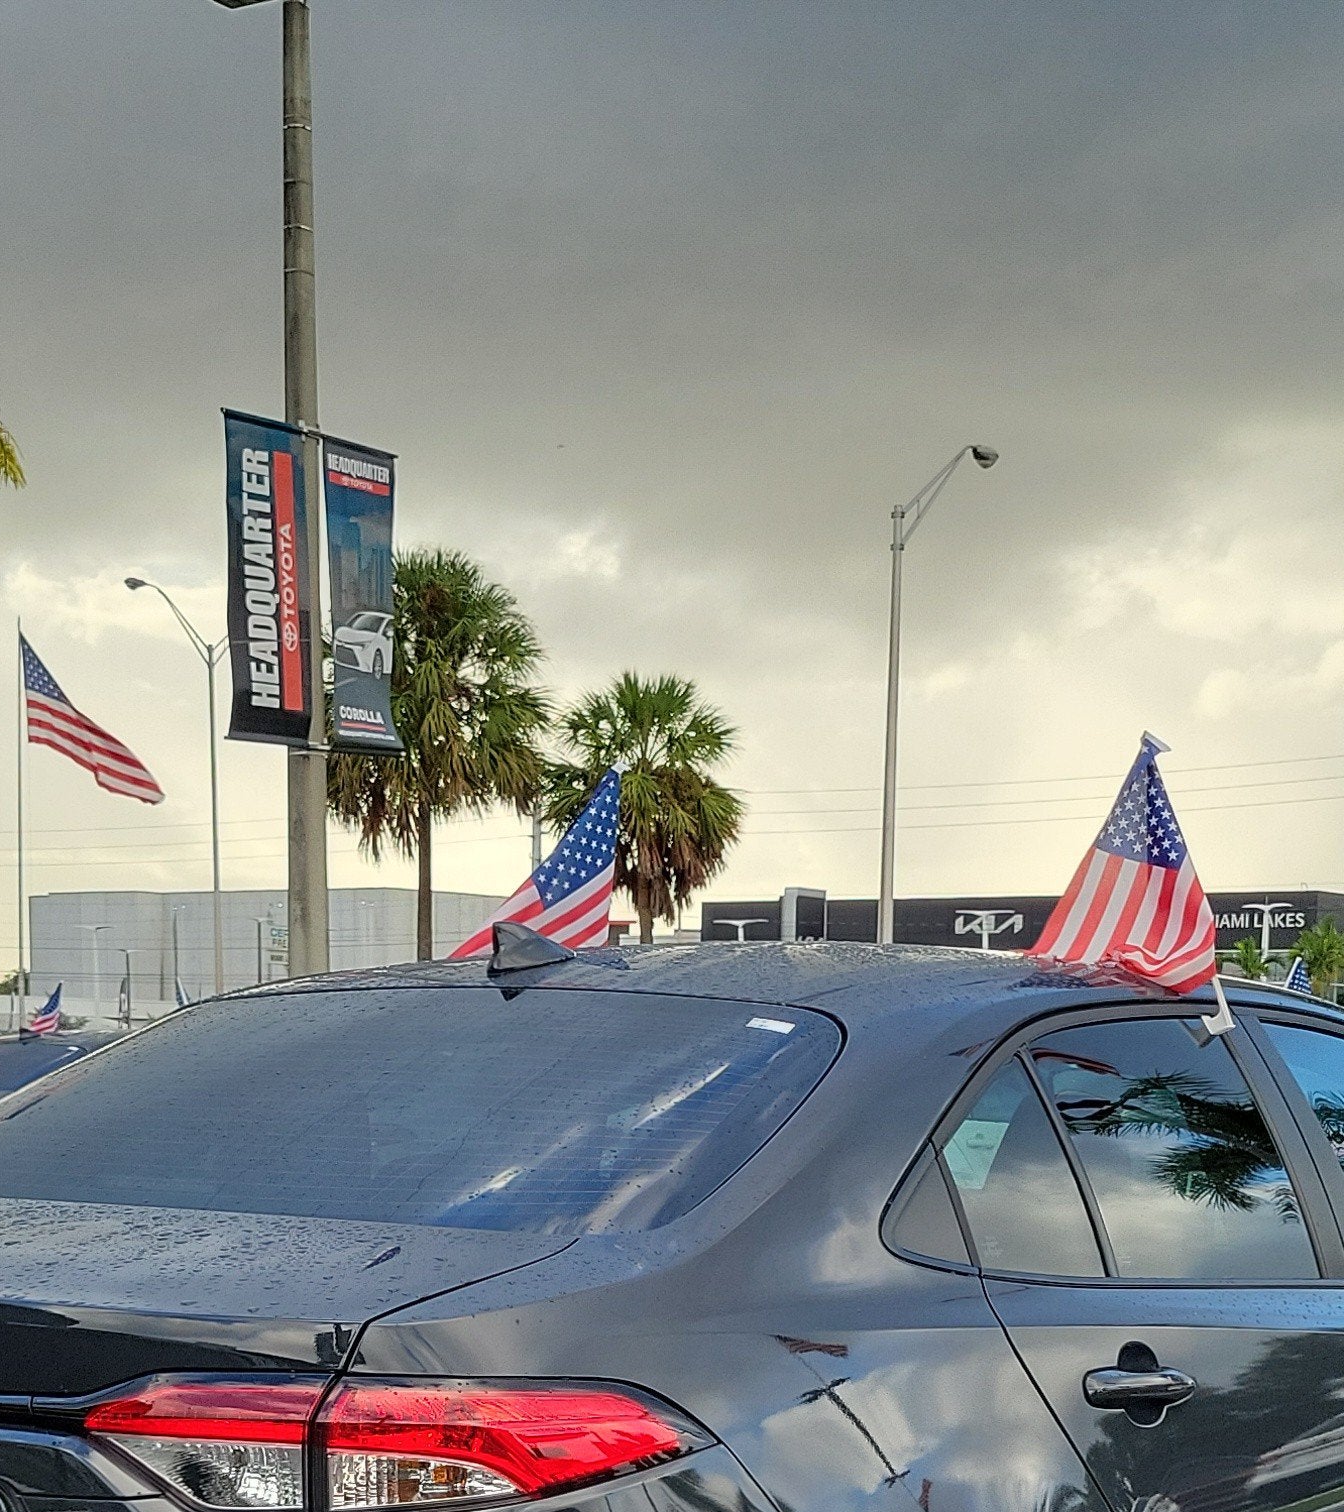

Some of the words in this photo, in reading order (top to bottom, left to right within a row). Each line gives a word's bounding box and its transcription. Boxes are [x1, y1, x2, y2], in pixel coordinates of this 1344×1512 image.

[242, 448, 281, 708] HEADQUARTER
[278, 523, 296, 618] TOYOTA
[339, 705, 385, 725] COROLLA
[1215, 913, 1249, 929] IAMI
[1253, 912, 1305, 928] LAKES
